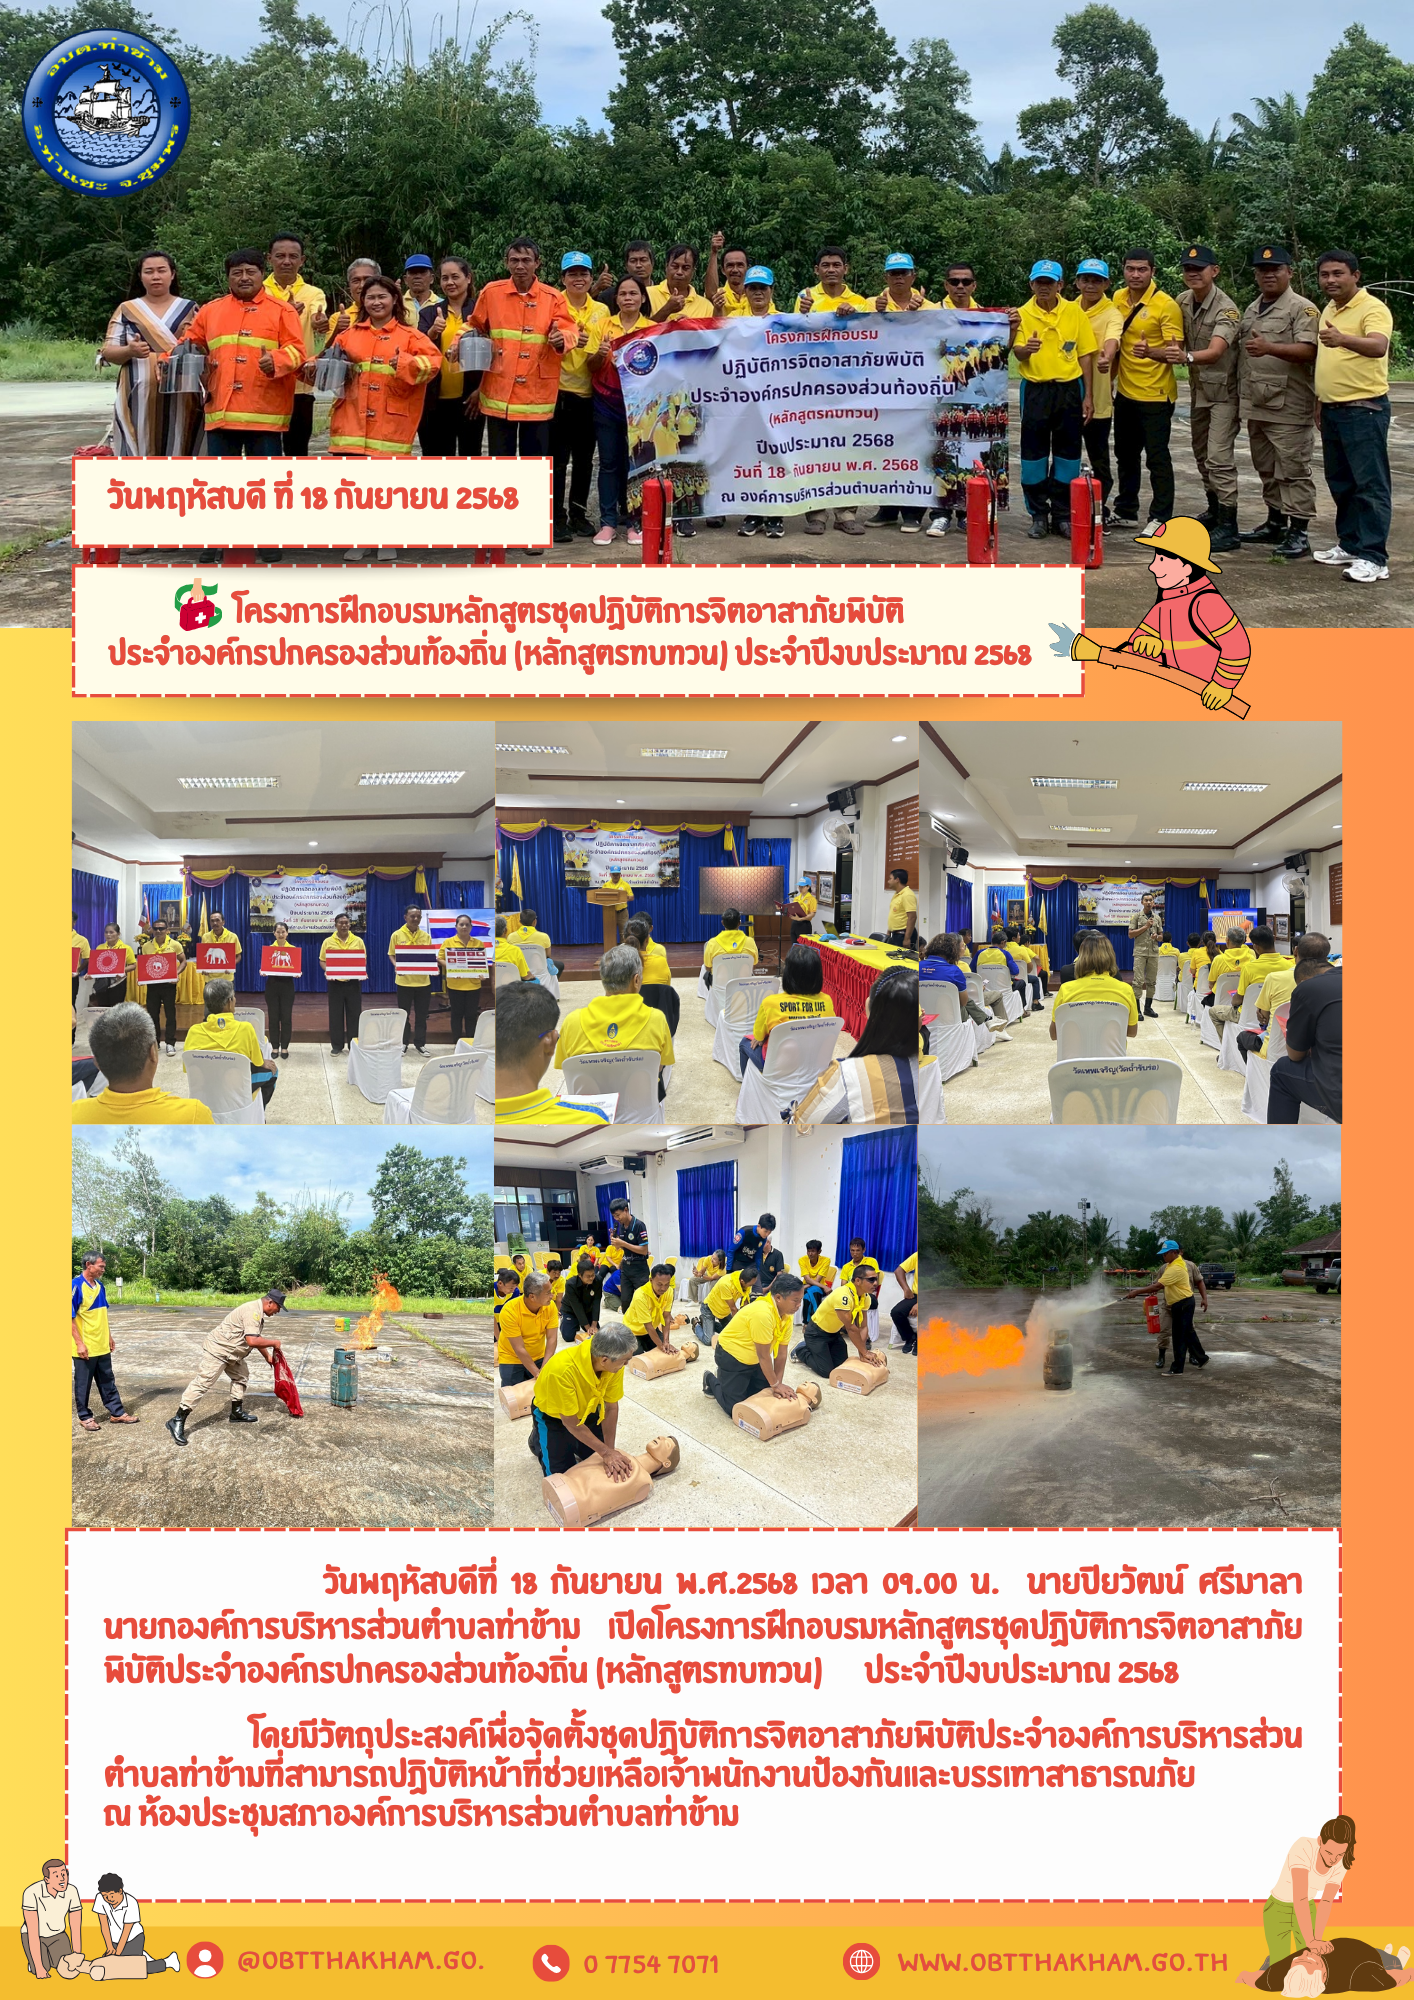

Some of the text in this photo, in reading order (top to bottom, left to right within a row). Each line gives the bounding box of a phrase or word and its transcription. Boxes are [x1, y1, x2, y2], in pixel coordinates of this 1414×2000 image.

[765, 327, 879, 346] โครงการฝึกอบรม
[722, 351, 925, 379] ปฏิบัติการจิตอาสาภัยพิบัติ
[690, 375, 956, 404] ประจำองค์กรปกครองส่วนท้องถิ่น
[769, 407, 879, 428] (หลักสูตรทบทวน)
[756, 433, 895, 455] ปีงบประมาณ 2568
[733, 458, 919, 479] วันที่ 18 กันยายน พ.ศ. 2568
[721, 480, 932, 504] ณ องค์การบริหารส่วนตำบลท่าข้าม
[780, 1001, 826, 1013] SPORT FOR LIFE
[842, 1296, 848, 1306] 9
